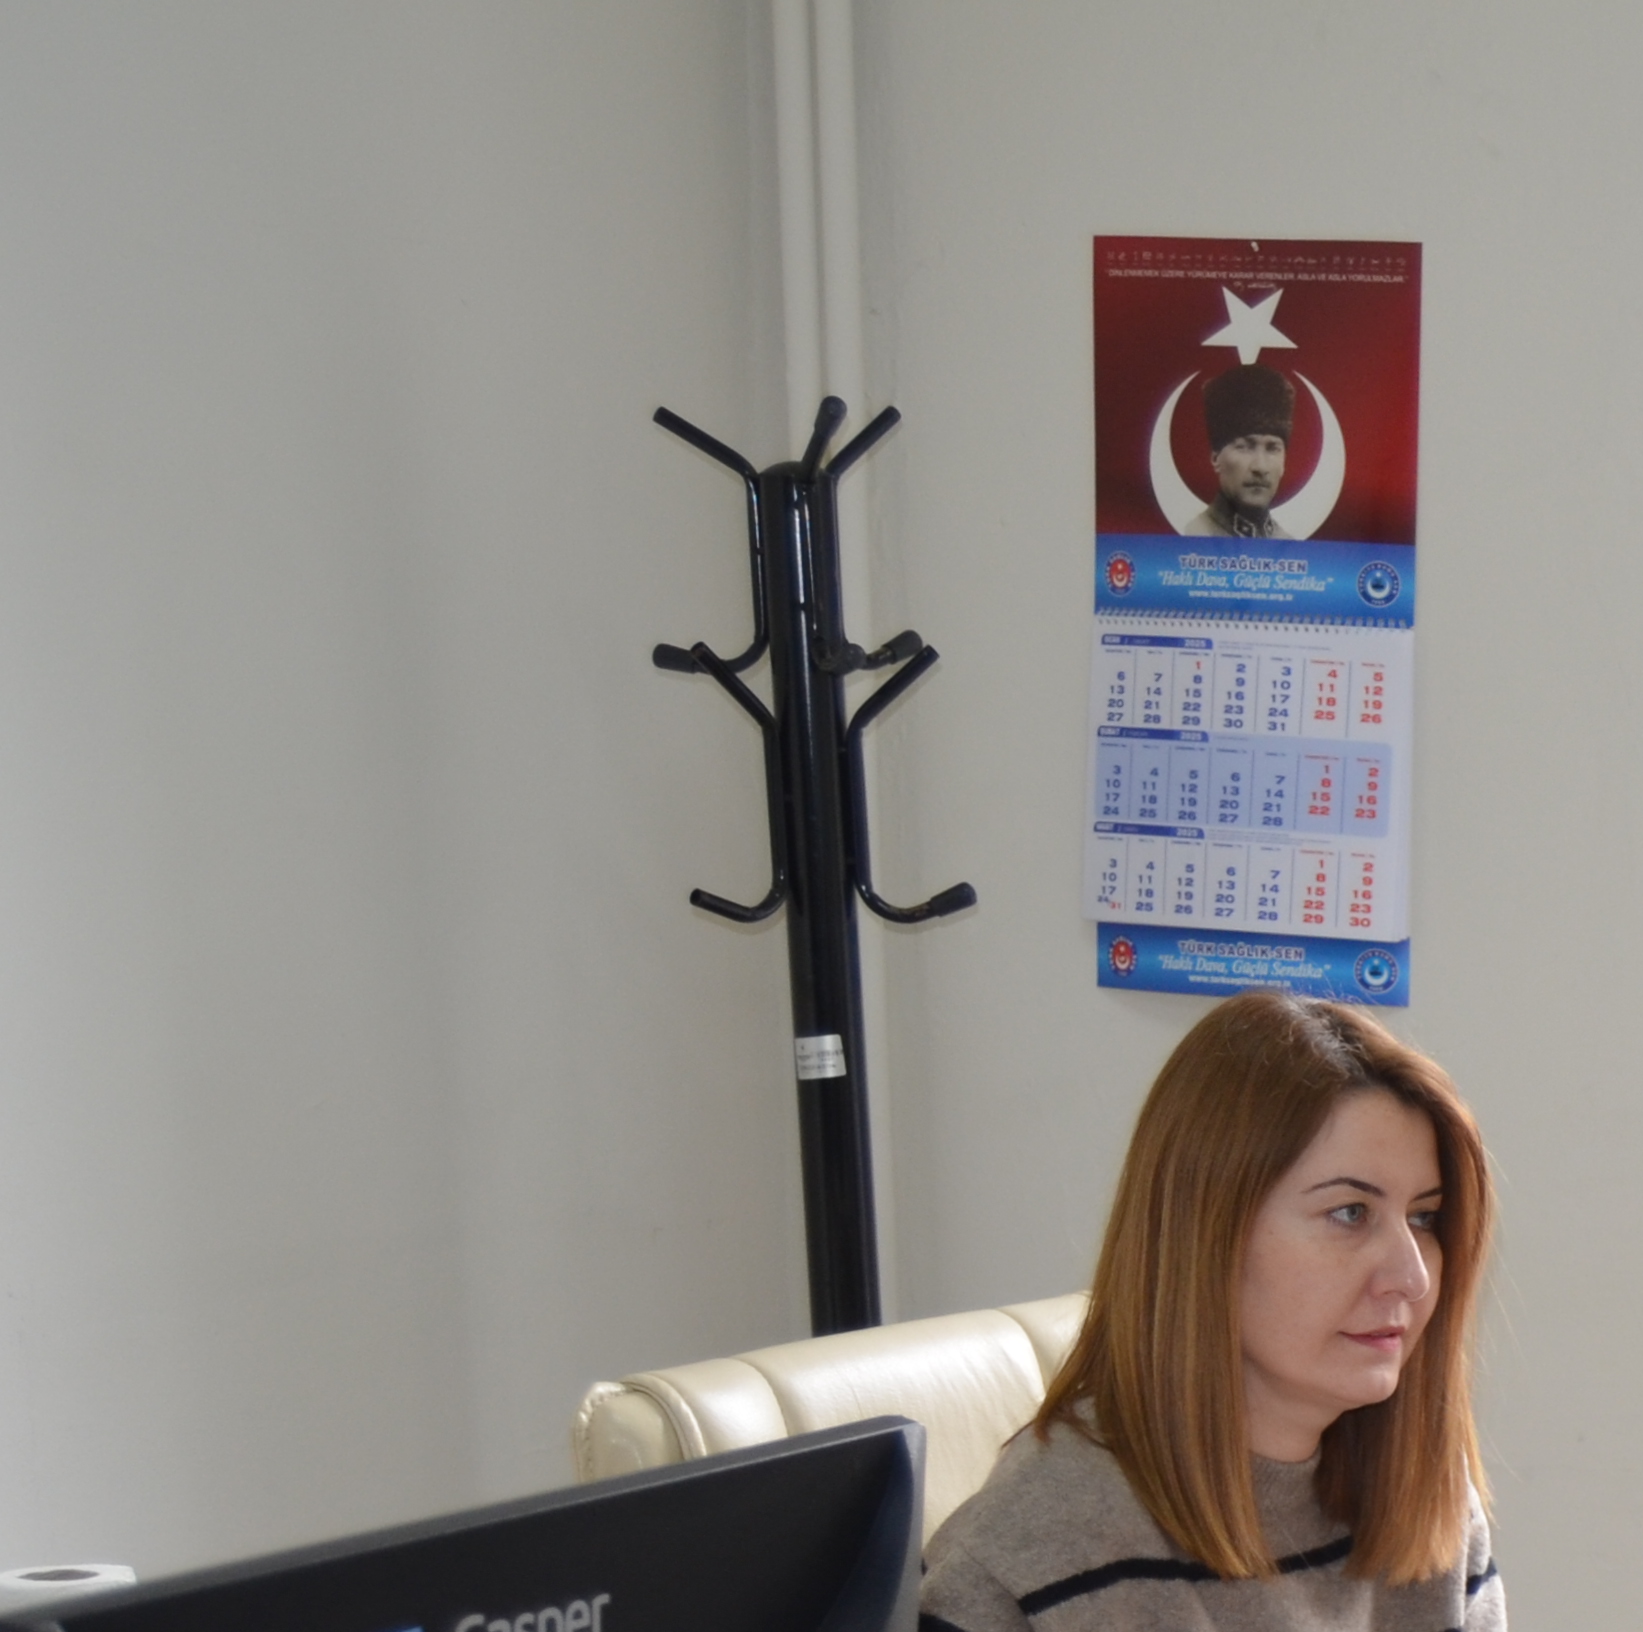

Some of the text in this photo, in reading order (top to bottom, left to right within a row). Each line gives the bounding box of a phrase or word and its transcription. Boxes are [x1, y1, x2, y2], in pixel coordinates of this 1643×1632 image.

[1180, 553, 1307, 574] TÜRK SAĞLIK-SEN
[1117, 671, 1383, 696] 6 7 8 9 10 11 12
[1196, 661, 1384, 682] 1 2 3 4 5
[1110, 685, 1383, 710] 13 14 15 16 17 18 19
[1107, 712, 1285, 731] 27 28 29 30 31
[1108, 698, 1382, 724] 20 21 22 23 24 25 26
[1113, 765, 1378, 791] 3 4 5 6 7 8 9
[1325, 765, 1379, 777] 1 2
[1106, 779, 1377, 805] 10 11 12 13 14 15 16
[1103, 806, 1283, 826] 24 25 26 27 28
[1106, 793, 1376, 819] 17 18 19 20 21 22 23
[1109, 859, 1373, 886] 3 4 5 6 7 8 9
[1319, 859, 1374, 872] 1 2
[1103, 872, 1372, 900] 10 11 12 13 14 15 16
[1101, 885, 1372, 914] 17 18 19 20 21 22 23
[1135, 901, 1153, 912] 25
[1174, 904, 1193, 914] 26
[1215, 908, 1234, 917] 27
[1258, 911, 1278, 921] 28
[1303, 914, 1324, 924] 29
[1349, 917, 1371, 927] 30
[1179, 939, 1305, 960] TÜRK SAĞLIK-SEN
